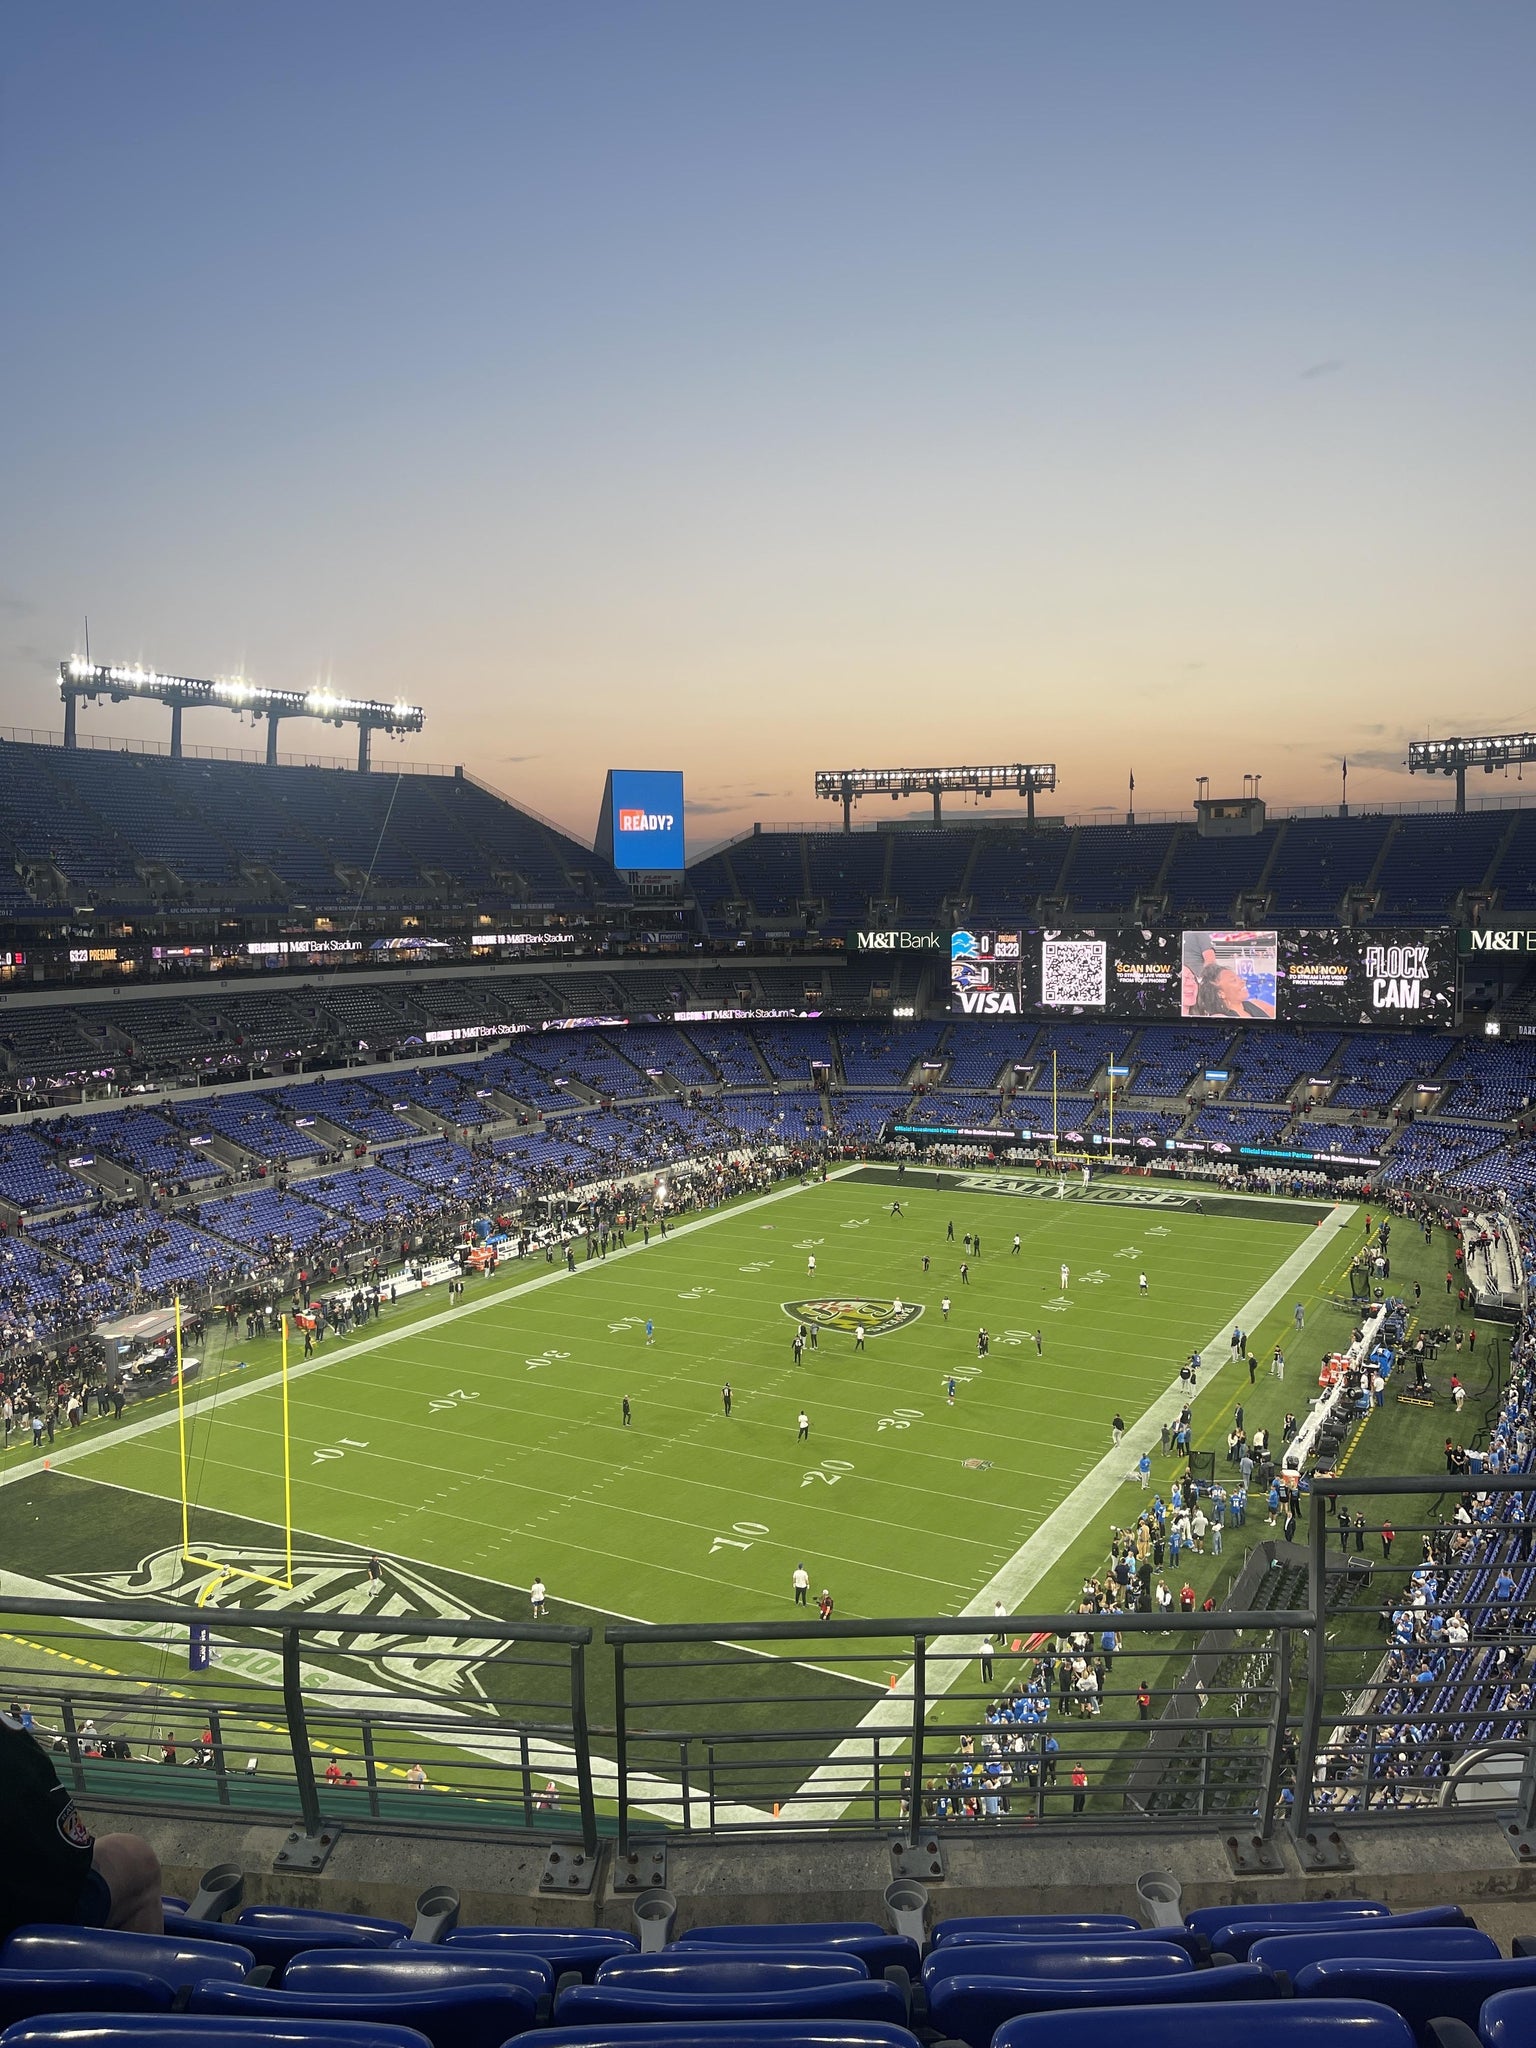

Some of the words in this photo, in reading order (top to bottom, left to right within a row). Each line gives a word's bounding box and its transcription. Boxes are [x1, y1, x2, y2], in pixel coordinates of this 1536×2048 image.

[623, 814, 674, 831] READY?
[248, 943, 279, 954] WELCOME
[280, 942, 288, 952] TO
[290, 941, 310, 952] M&T
[310, 940, 330, 951] Bank
[330, 940, 362, 951] Stadium
[472, 935, 497, 945] WELCOME
[498, 935, 505, 944] TO
[507, 934, 526, 944] M&T
[526, 934, 544, 943] Bank
[544, 933, 574, 943] Stadium
[857, 932, 899, 948] M&T
[900, 932, 940, 948] Bank
[981, 936, 989, 953] 0
[1470, 930, 1525, 950] M&T
[69, 950, 88, 962] 63:23
[89, 949, 117, 961] PREGAME
[995, 943, 1019, 957] 63:23
[1117, 964, 1143, 972] SCAN
[1145, 964, 1171, 973] NOW
[1290, 965, 1318, 974] SCAN
[1320, 966, 1348, 974] NOW
[1366, 946, 1429, 978] FLOCK
[981, 967, 989, 984] 0
[1373, 978, 1420, 1008] CAM
[955, 992, 1016, 1014] VISA
[674, 1012, 703, 1021] WELCOME
[714, 1010, 736, 1019] M&T
[736, 1010, 755, 1018] Bank
[756, 1009, 789, 1018] Stadium
[426, 1030, 453, 1042] WELCOME
[462, 1027, 480, 1038] M&T
[480, 1026, 498, 1036] Bank
[498, 1024, 526, 1034] Stadium
[1331, 1155, 1359, 1164] Baltimore
[1359, 1157, 1380, 1166] Ravens
[964, 1177, 1188, 1206] BALTIMORE
[1078, 1271, 1111, 1284] 30
[678, 1286, 716, 1300] 50
[1040, 1298, 1074, 1312] 40
[607, 1316, 644, 1331] 40
[993, 1330, 1032, 1346] 50
[525, 1349, 571, 1368] 30
[428, 1388, 480, 1410] 20
[877, 1408, 924, 1429] 30
[313, 1437, 369, 1460] 10
[802, 1460, 854, 1485] 20
[712, 1521, 770, 1551] 10
